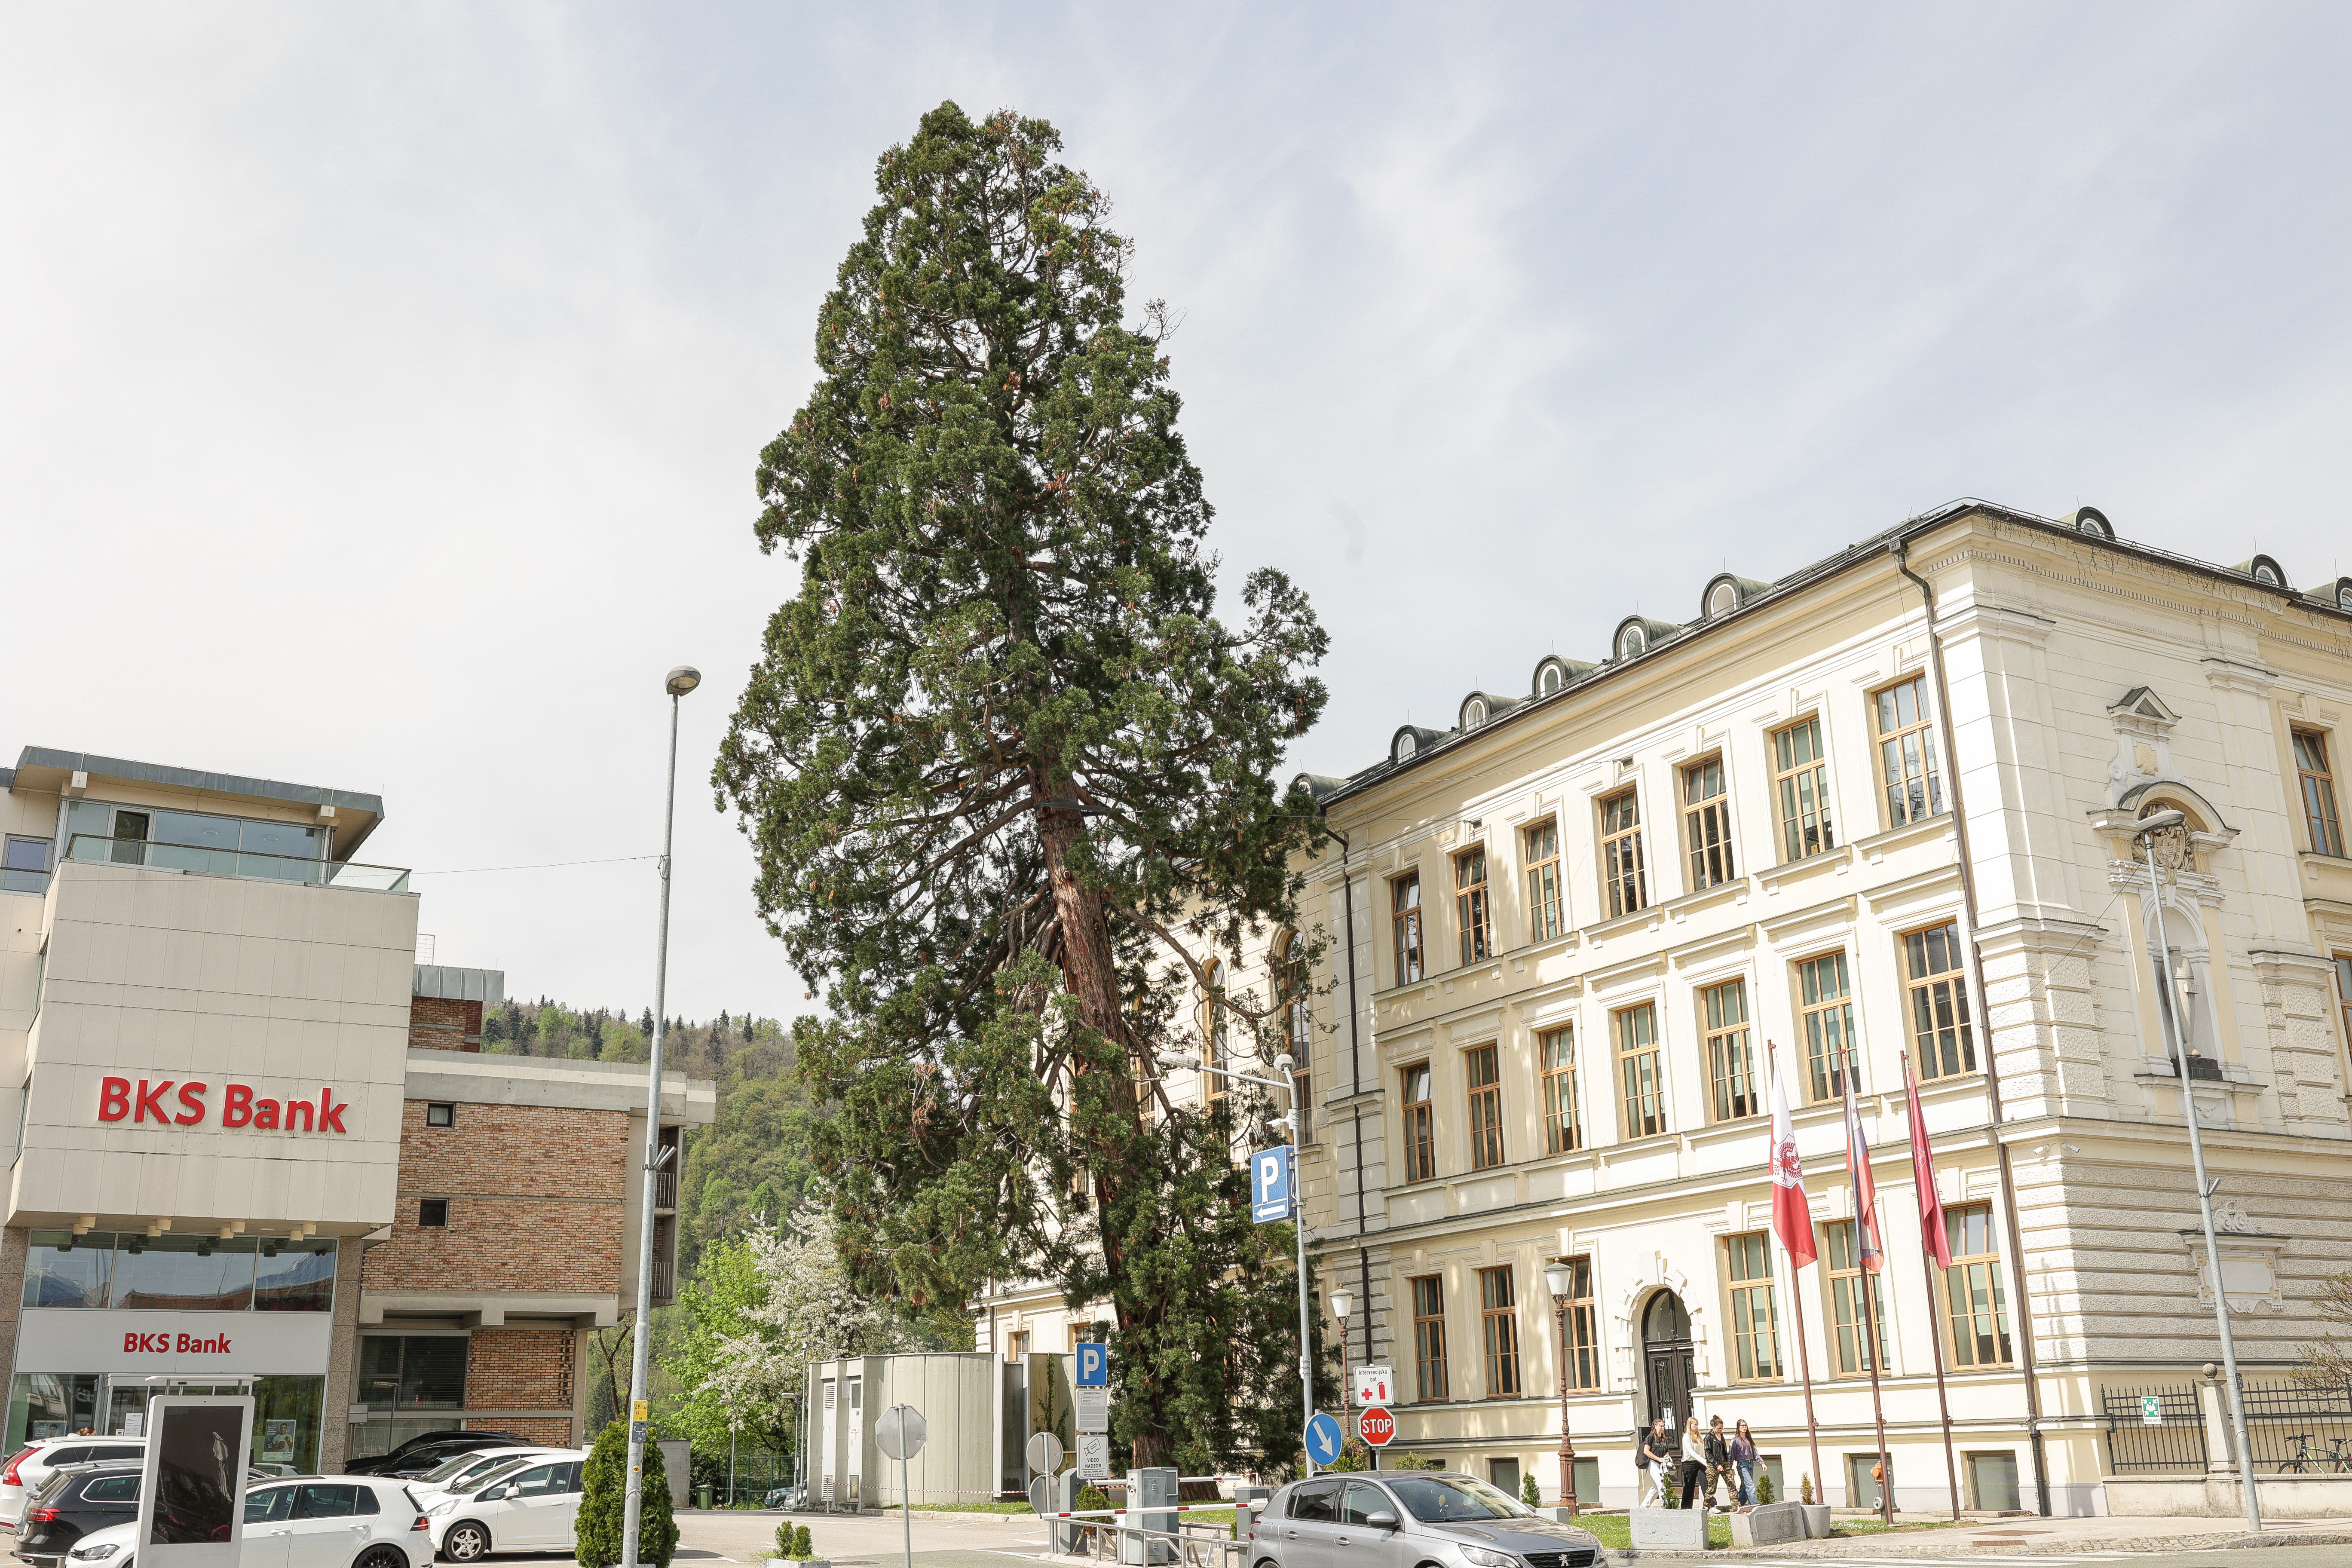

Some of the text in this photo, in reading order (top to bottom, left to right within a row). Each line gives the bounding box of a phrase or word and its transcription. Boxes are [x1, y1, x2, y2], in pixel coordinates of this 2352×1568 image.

[98, 1077, 349, 1133] BKS Bank
[1261, 1156, 1279, 1202] P
[124, 1332, 232, 1354] BKS Bank
[1083, 1349, 1099, 1380] P
[1362, 1419, 1392, 1433] STOP
